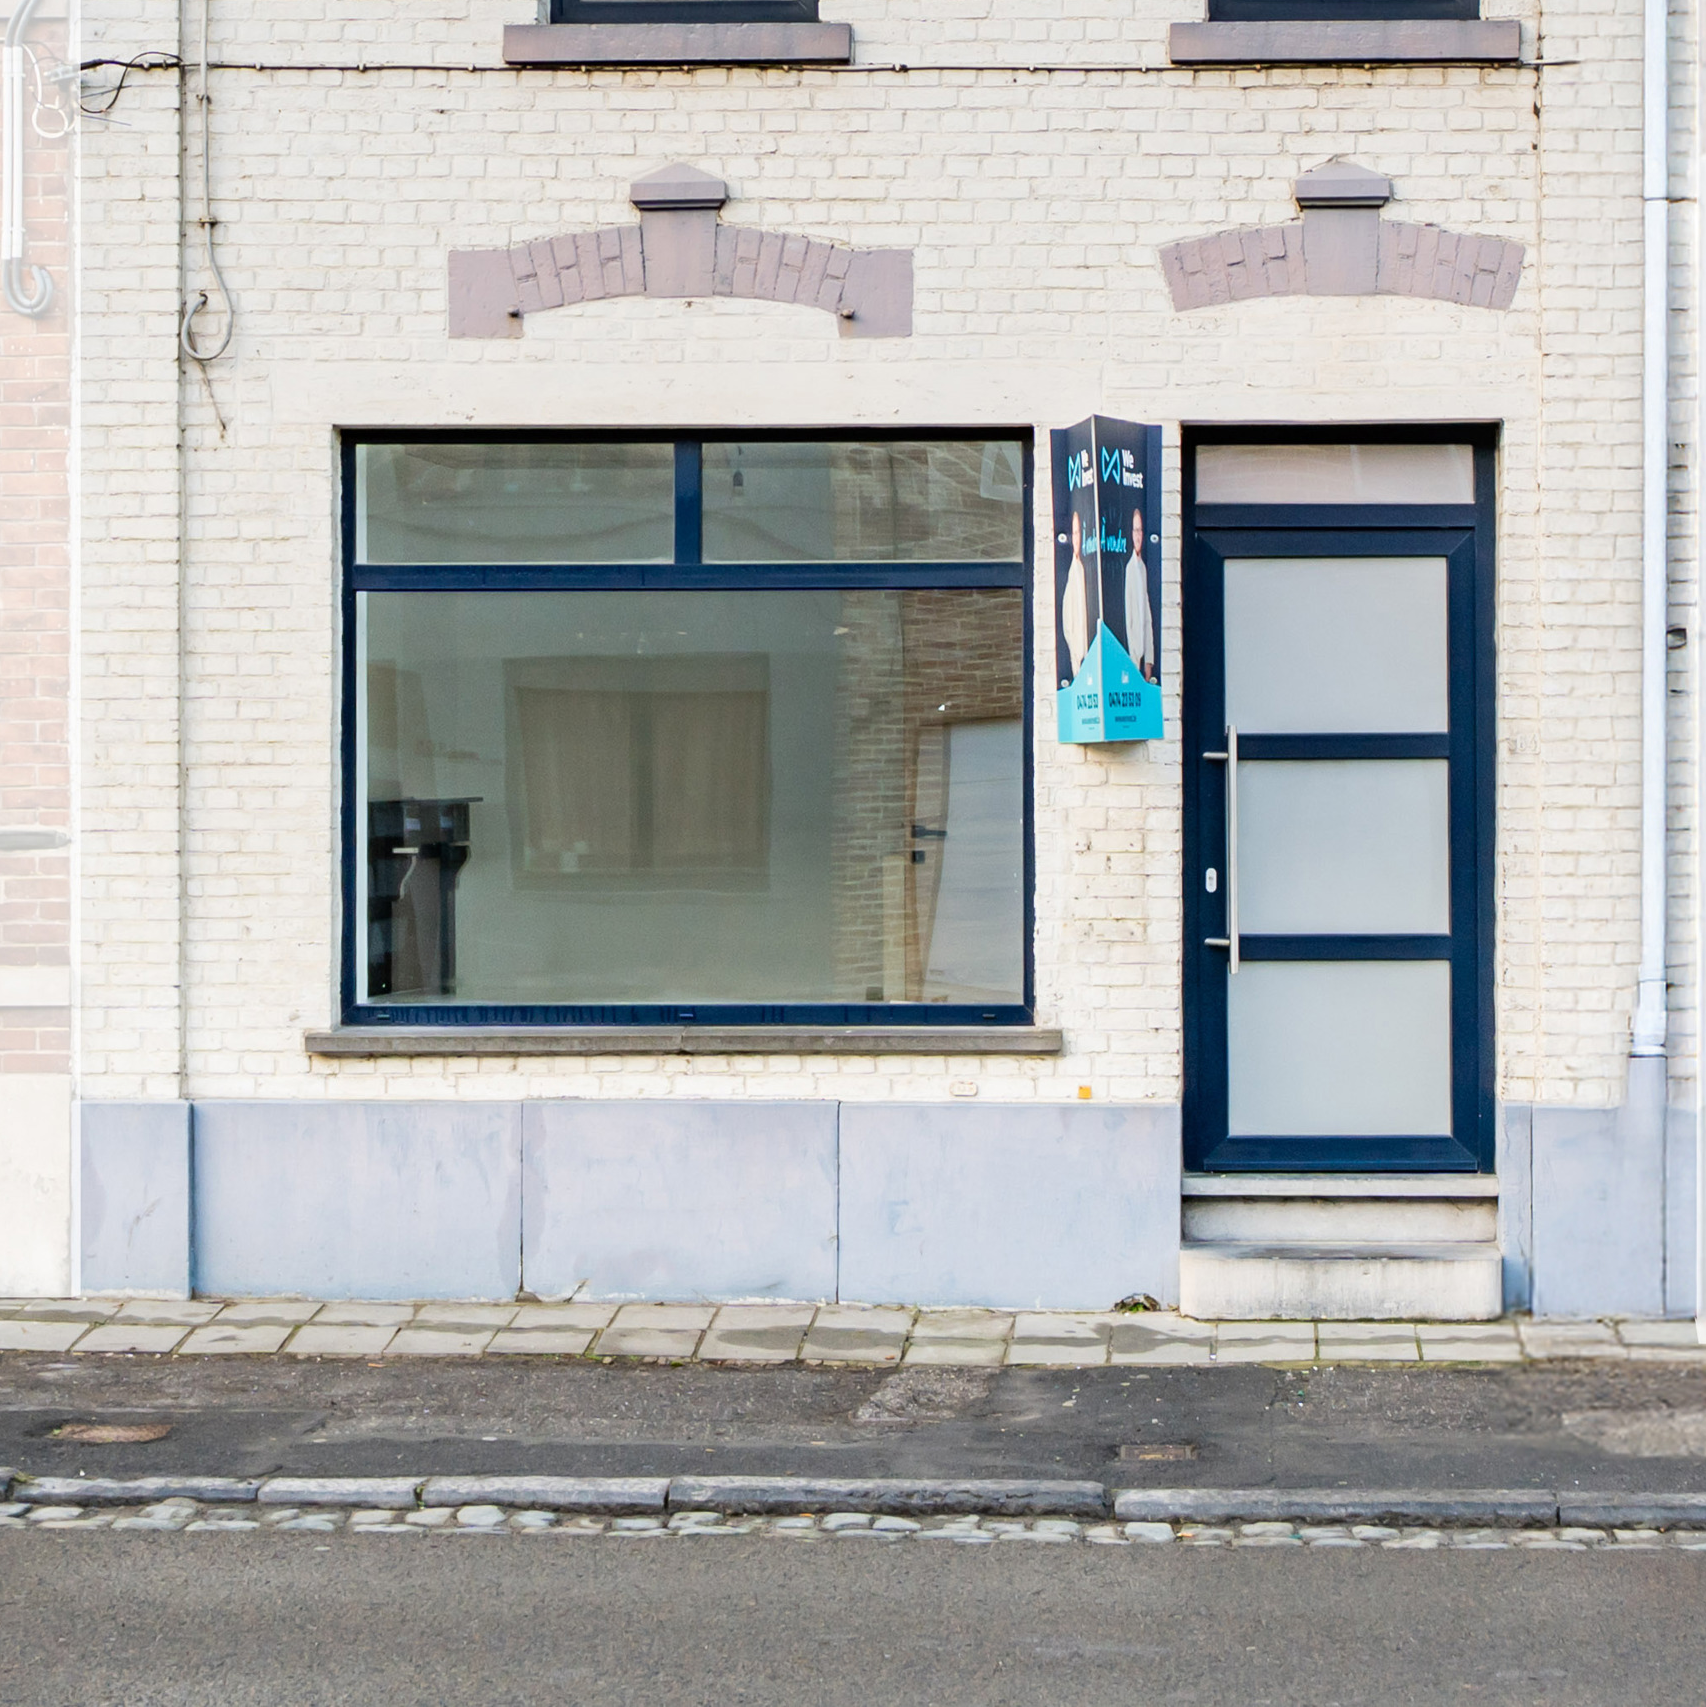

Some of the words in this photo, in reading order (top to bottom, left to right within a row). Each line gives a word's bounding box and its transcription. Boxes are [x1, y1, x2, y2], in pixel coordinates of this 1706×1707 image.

[1121, 449, 1134, 469] We
[1122, 467, 1144, 489] Invest
[1109, 692, 1121, 708] 0474
